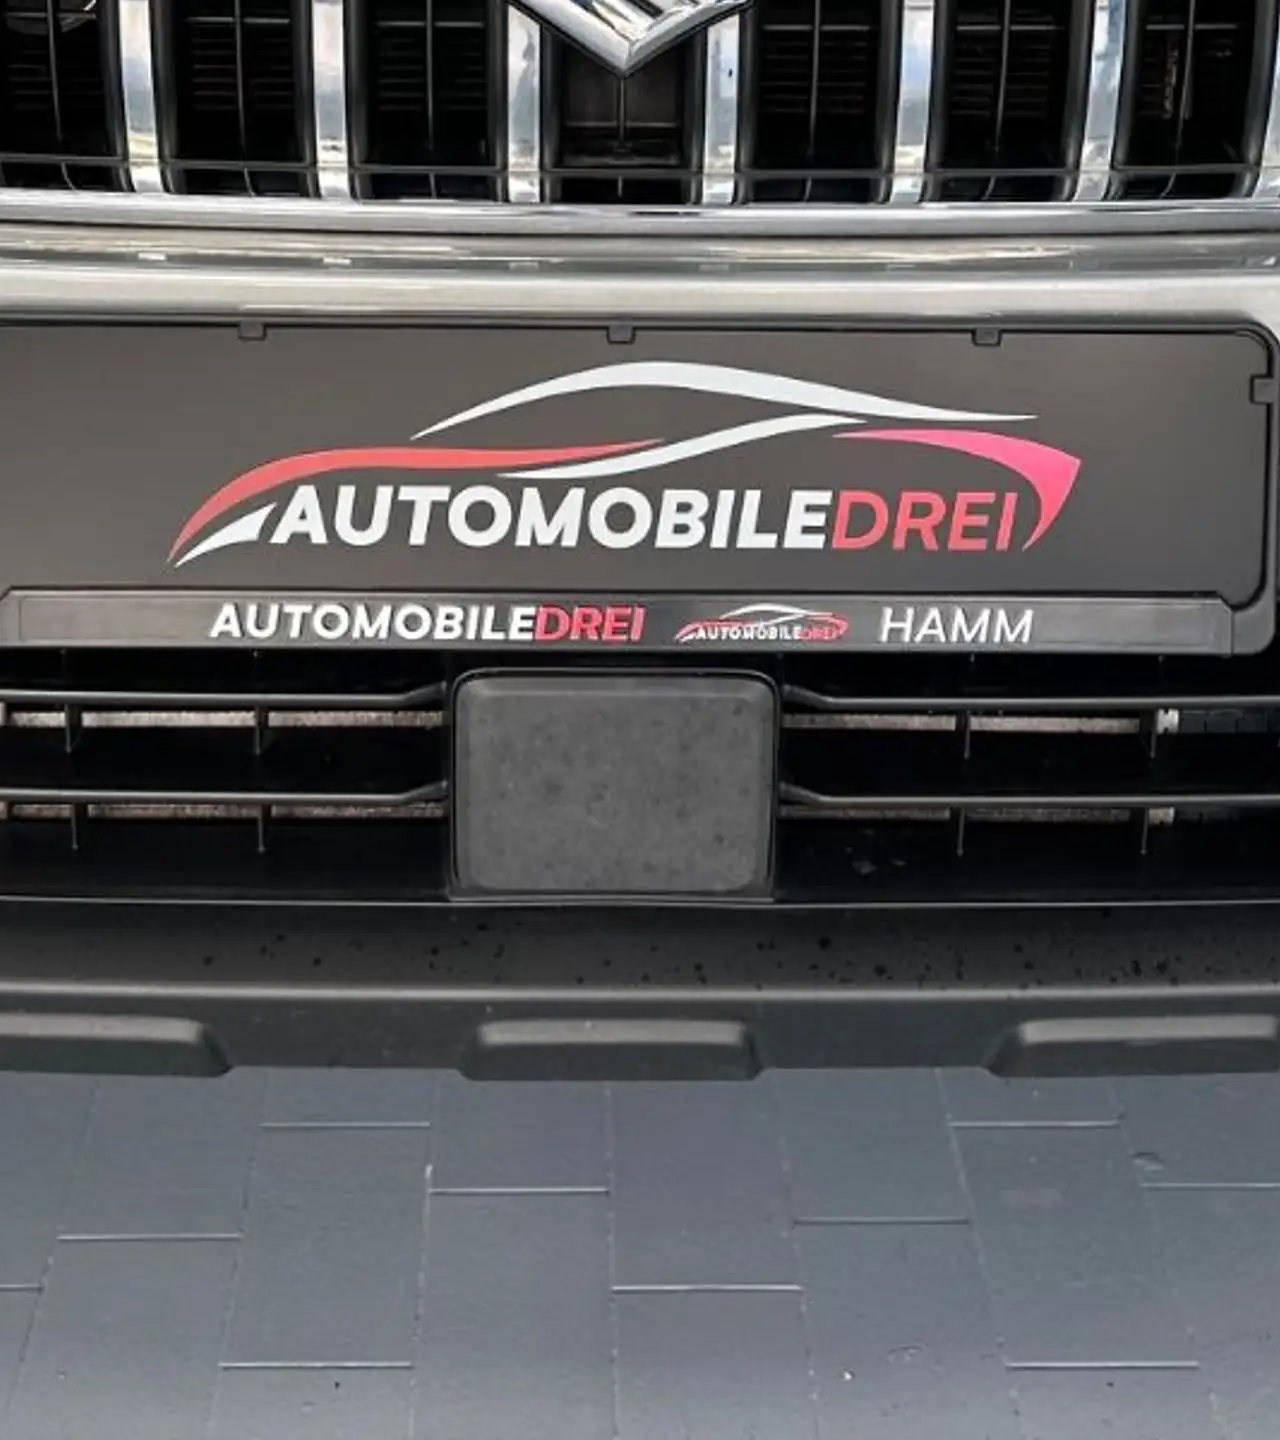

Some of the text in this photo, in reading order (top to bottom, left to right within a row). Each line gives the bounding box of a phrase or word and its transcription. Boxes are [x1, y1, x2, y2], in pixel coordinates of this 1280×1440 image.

[270, 484, 1018, 552] AUTOMOBILEDREI
[209, 602, 647, 643] AUTOMOBILEDREI
[879, 605, 1034, 644] HAMM
